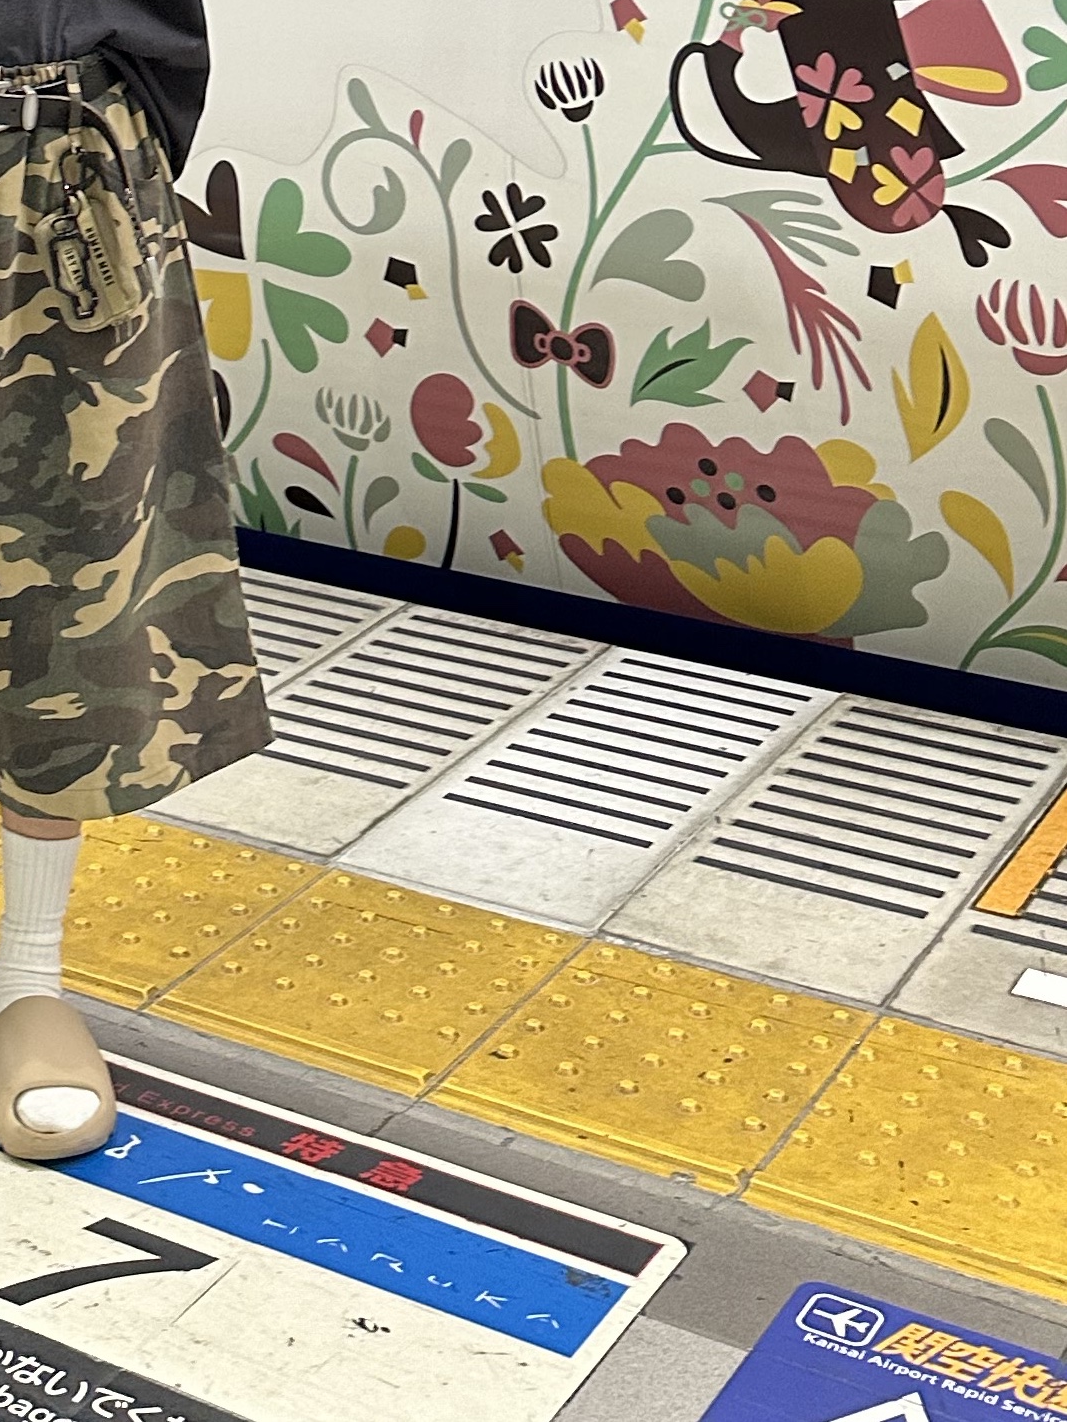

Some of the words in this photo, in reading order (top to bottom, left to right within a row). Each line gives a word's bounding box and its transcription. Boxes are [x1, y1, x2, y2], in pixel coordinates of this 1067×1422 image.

[85, 227, 104, 258] HUMAN
[137, 1090, 256, 1137] Express
[280, 1132, 424, 1193] 特急
[262, 1218, 560, 1329] HARUKA
[803, 1332, 866, 1361] Kansai
[867, 1355, 937, 1386] Airport
[941, 1381, 1000, 1406] Rapid
